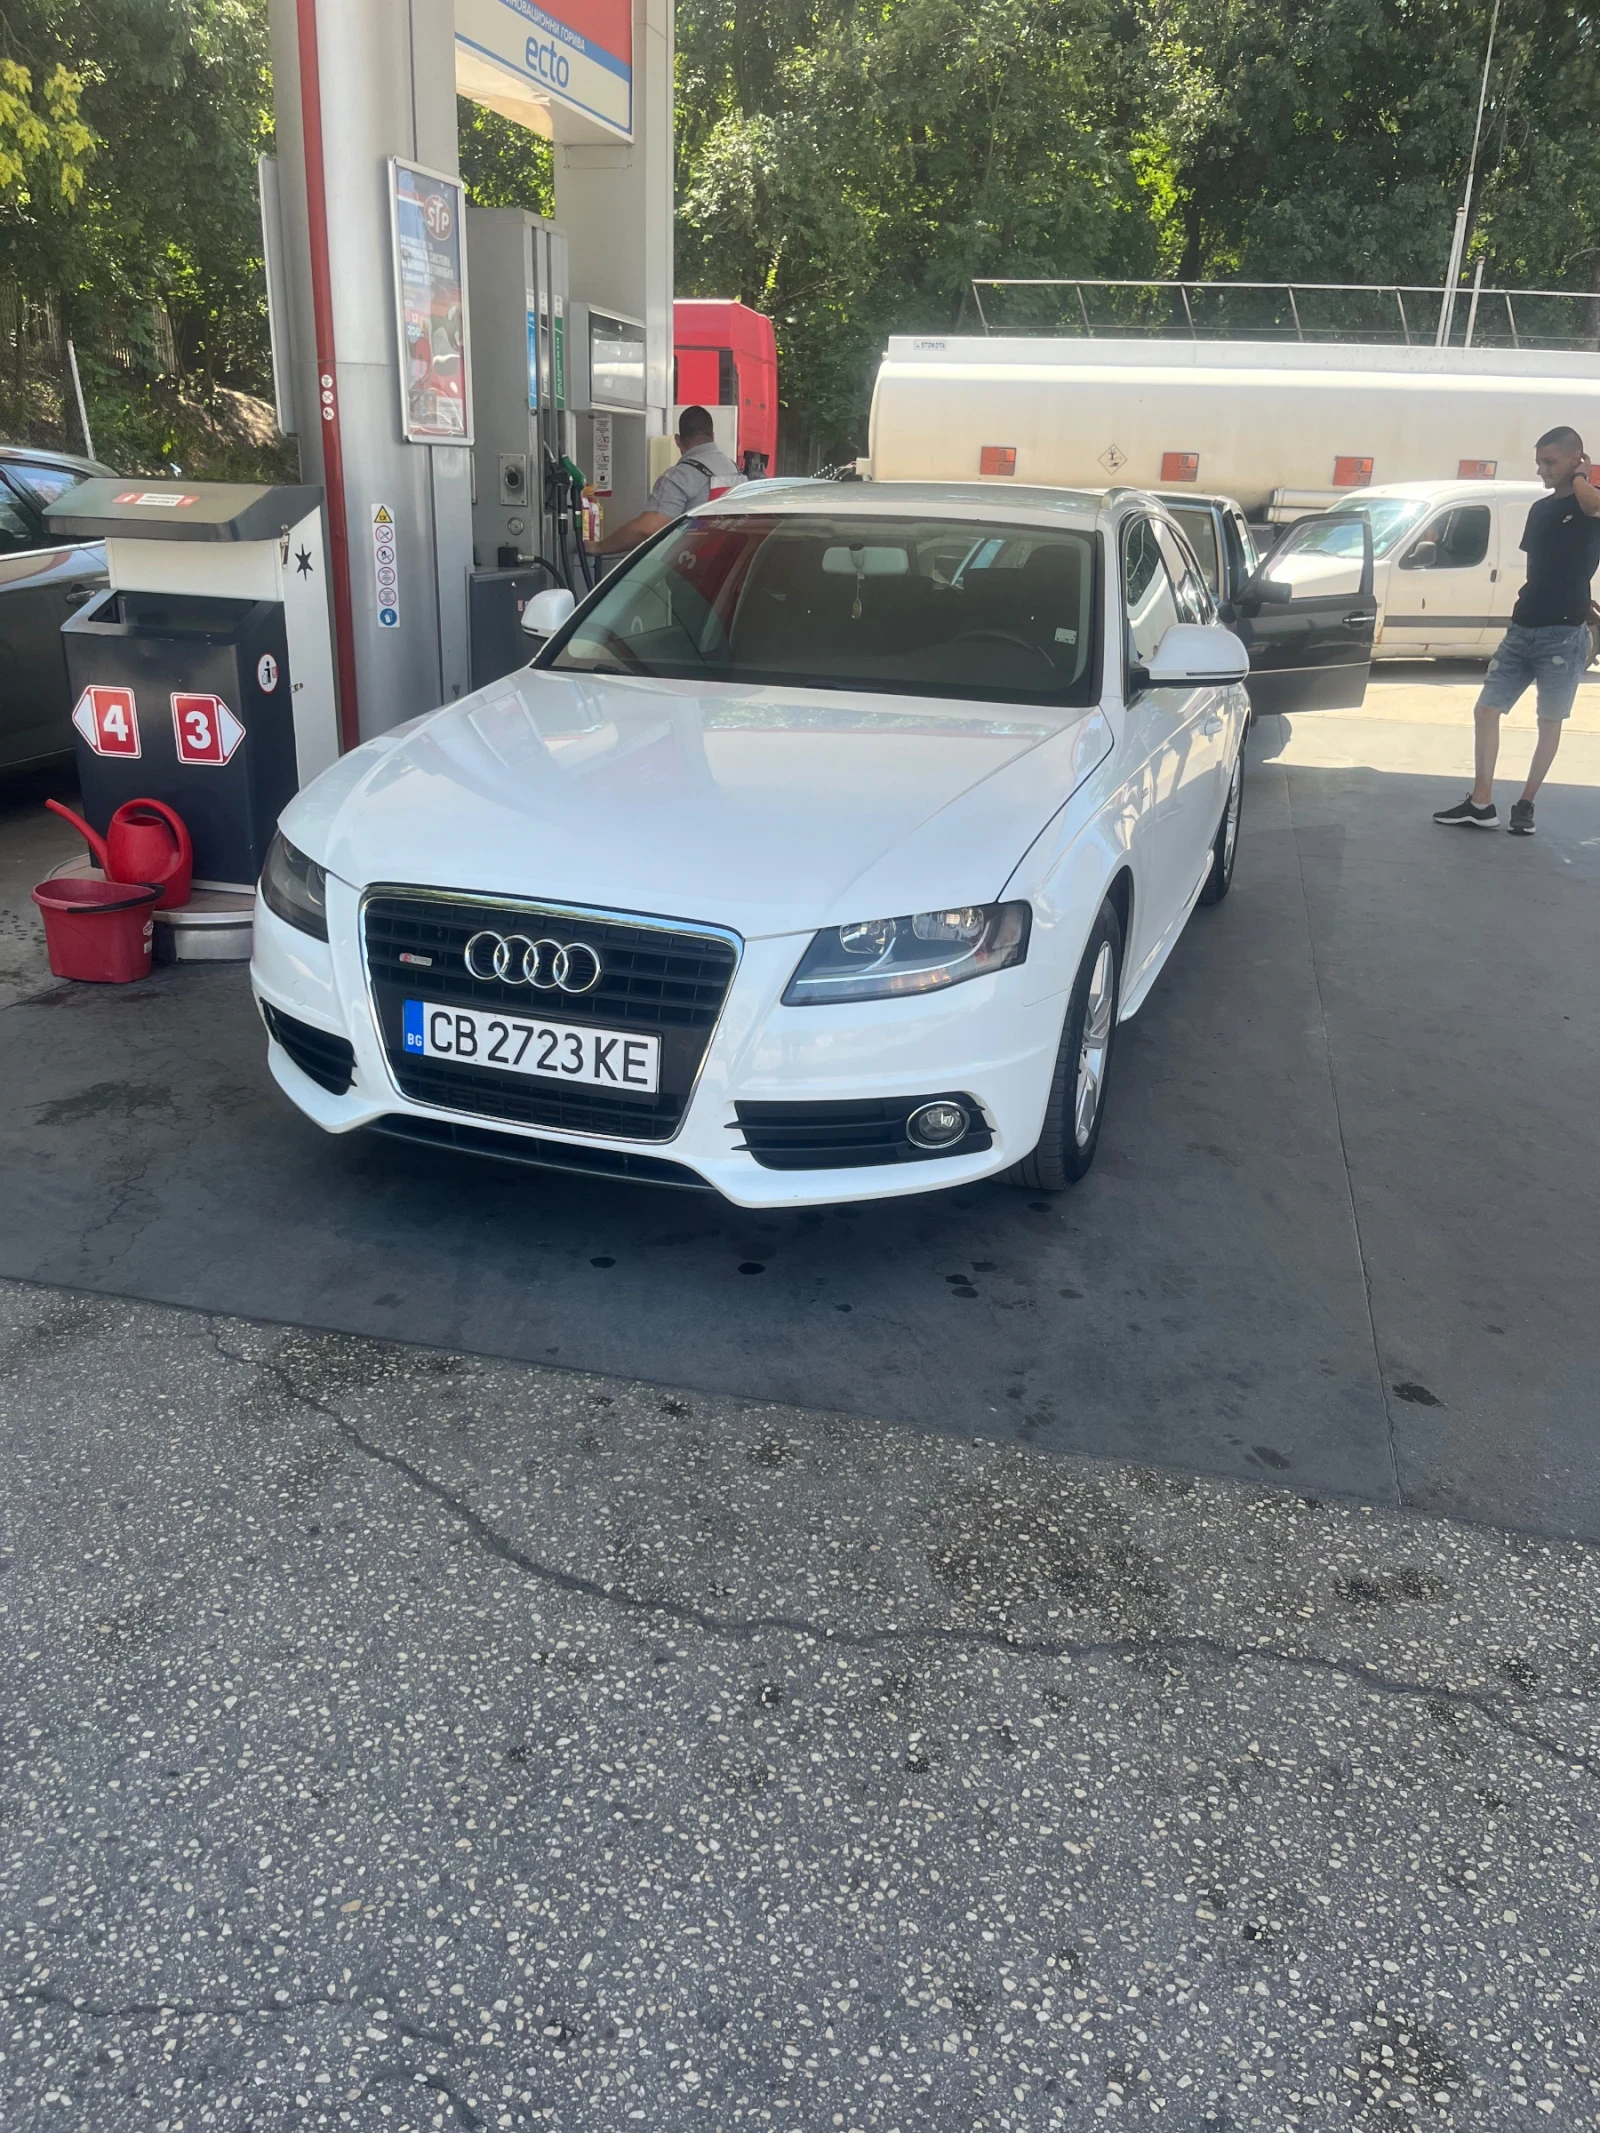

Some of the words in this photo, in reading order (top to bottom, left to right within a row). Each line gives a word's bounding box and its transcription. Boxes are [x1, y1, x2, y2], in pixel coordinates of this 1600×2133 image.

[561, 26, 585, 51] ГОРИВА
[525, 36, 569, 88] ecto
[427, 200, 449, 234] STP
[103, 704, 129, 742] 4
[185, 710, 212, 749] 3
[407, 1032, 422, 1047] BG
[430, 1011, 477, 1057] CB
[487, 1021, 583, 1074] 2723
[594, 1036, 648, 1084] KE
